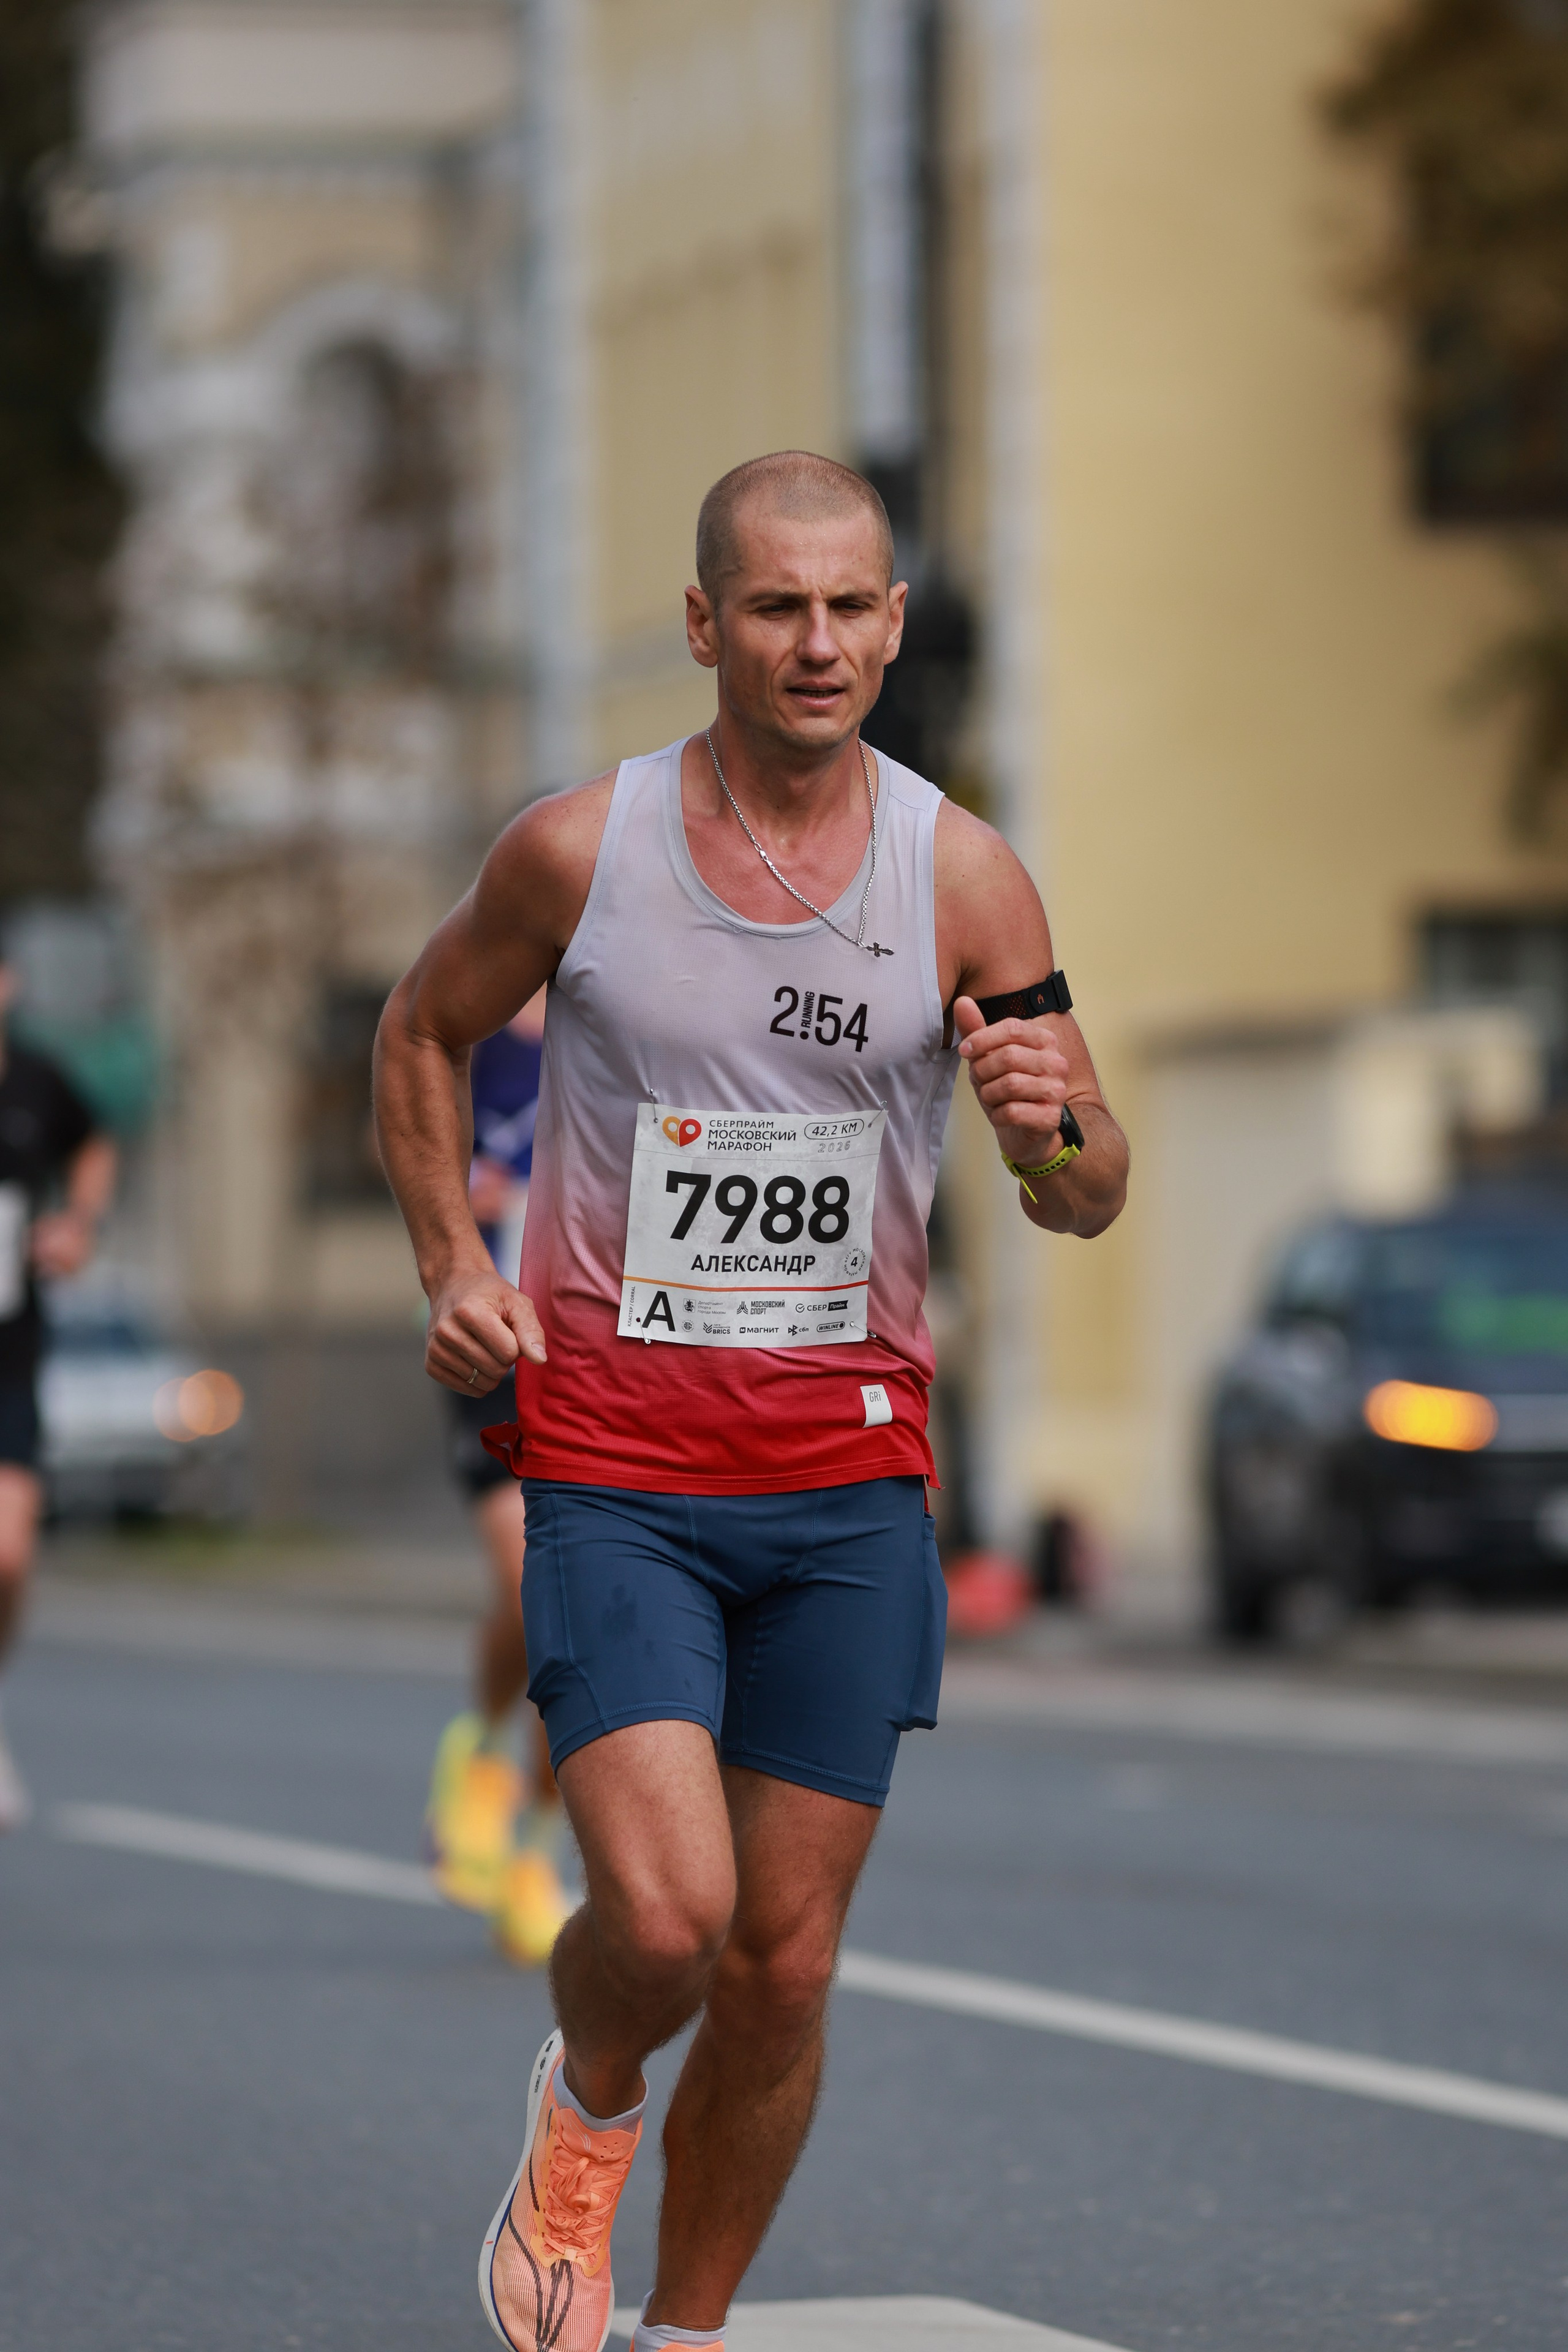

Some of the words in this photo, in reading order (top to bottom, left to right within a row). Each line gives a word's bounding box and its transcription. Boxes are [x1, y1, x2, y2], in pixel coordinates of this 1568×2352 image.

[801, 991, 815, 1028] RUNNING
[709, 1119, 774, 1129] СБЕРПРАЙМ
[708, 1129, 796, 1141] МОСКОВСКИЙ
[812, 1126, 837, 1136] 42,2
[707, 1141, 772, 1152] МАРАФОН
[818, 1140, 851, 1153] 2026
[666, 1170, 850, 1244] 7988
[691, 1254, 816, 1275] АЛЕКСАНДР
[851, 1256, 858, 1267] 4
[869, 1391, 881, 1402] GRi
